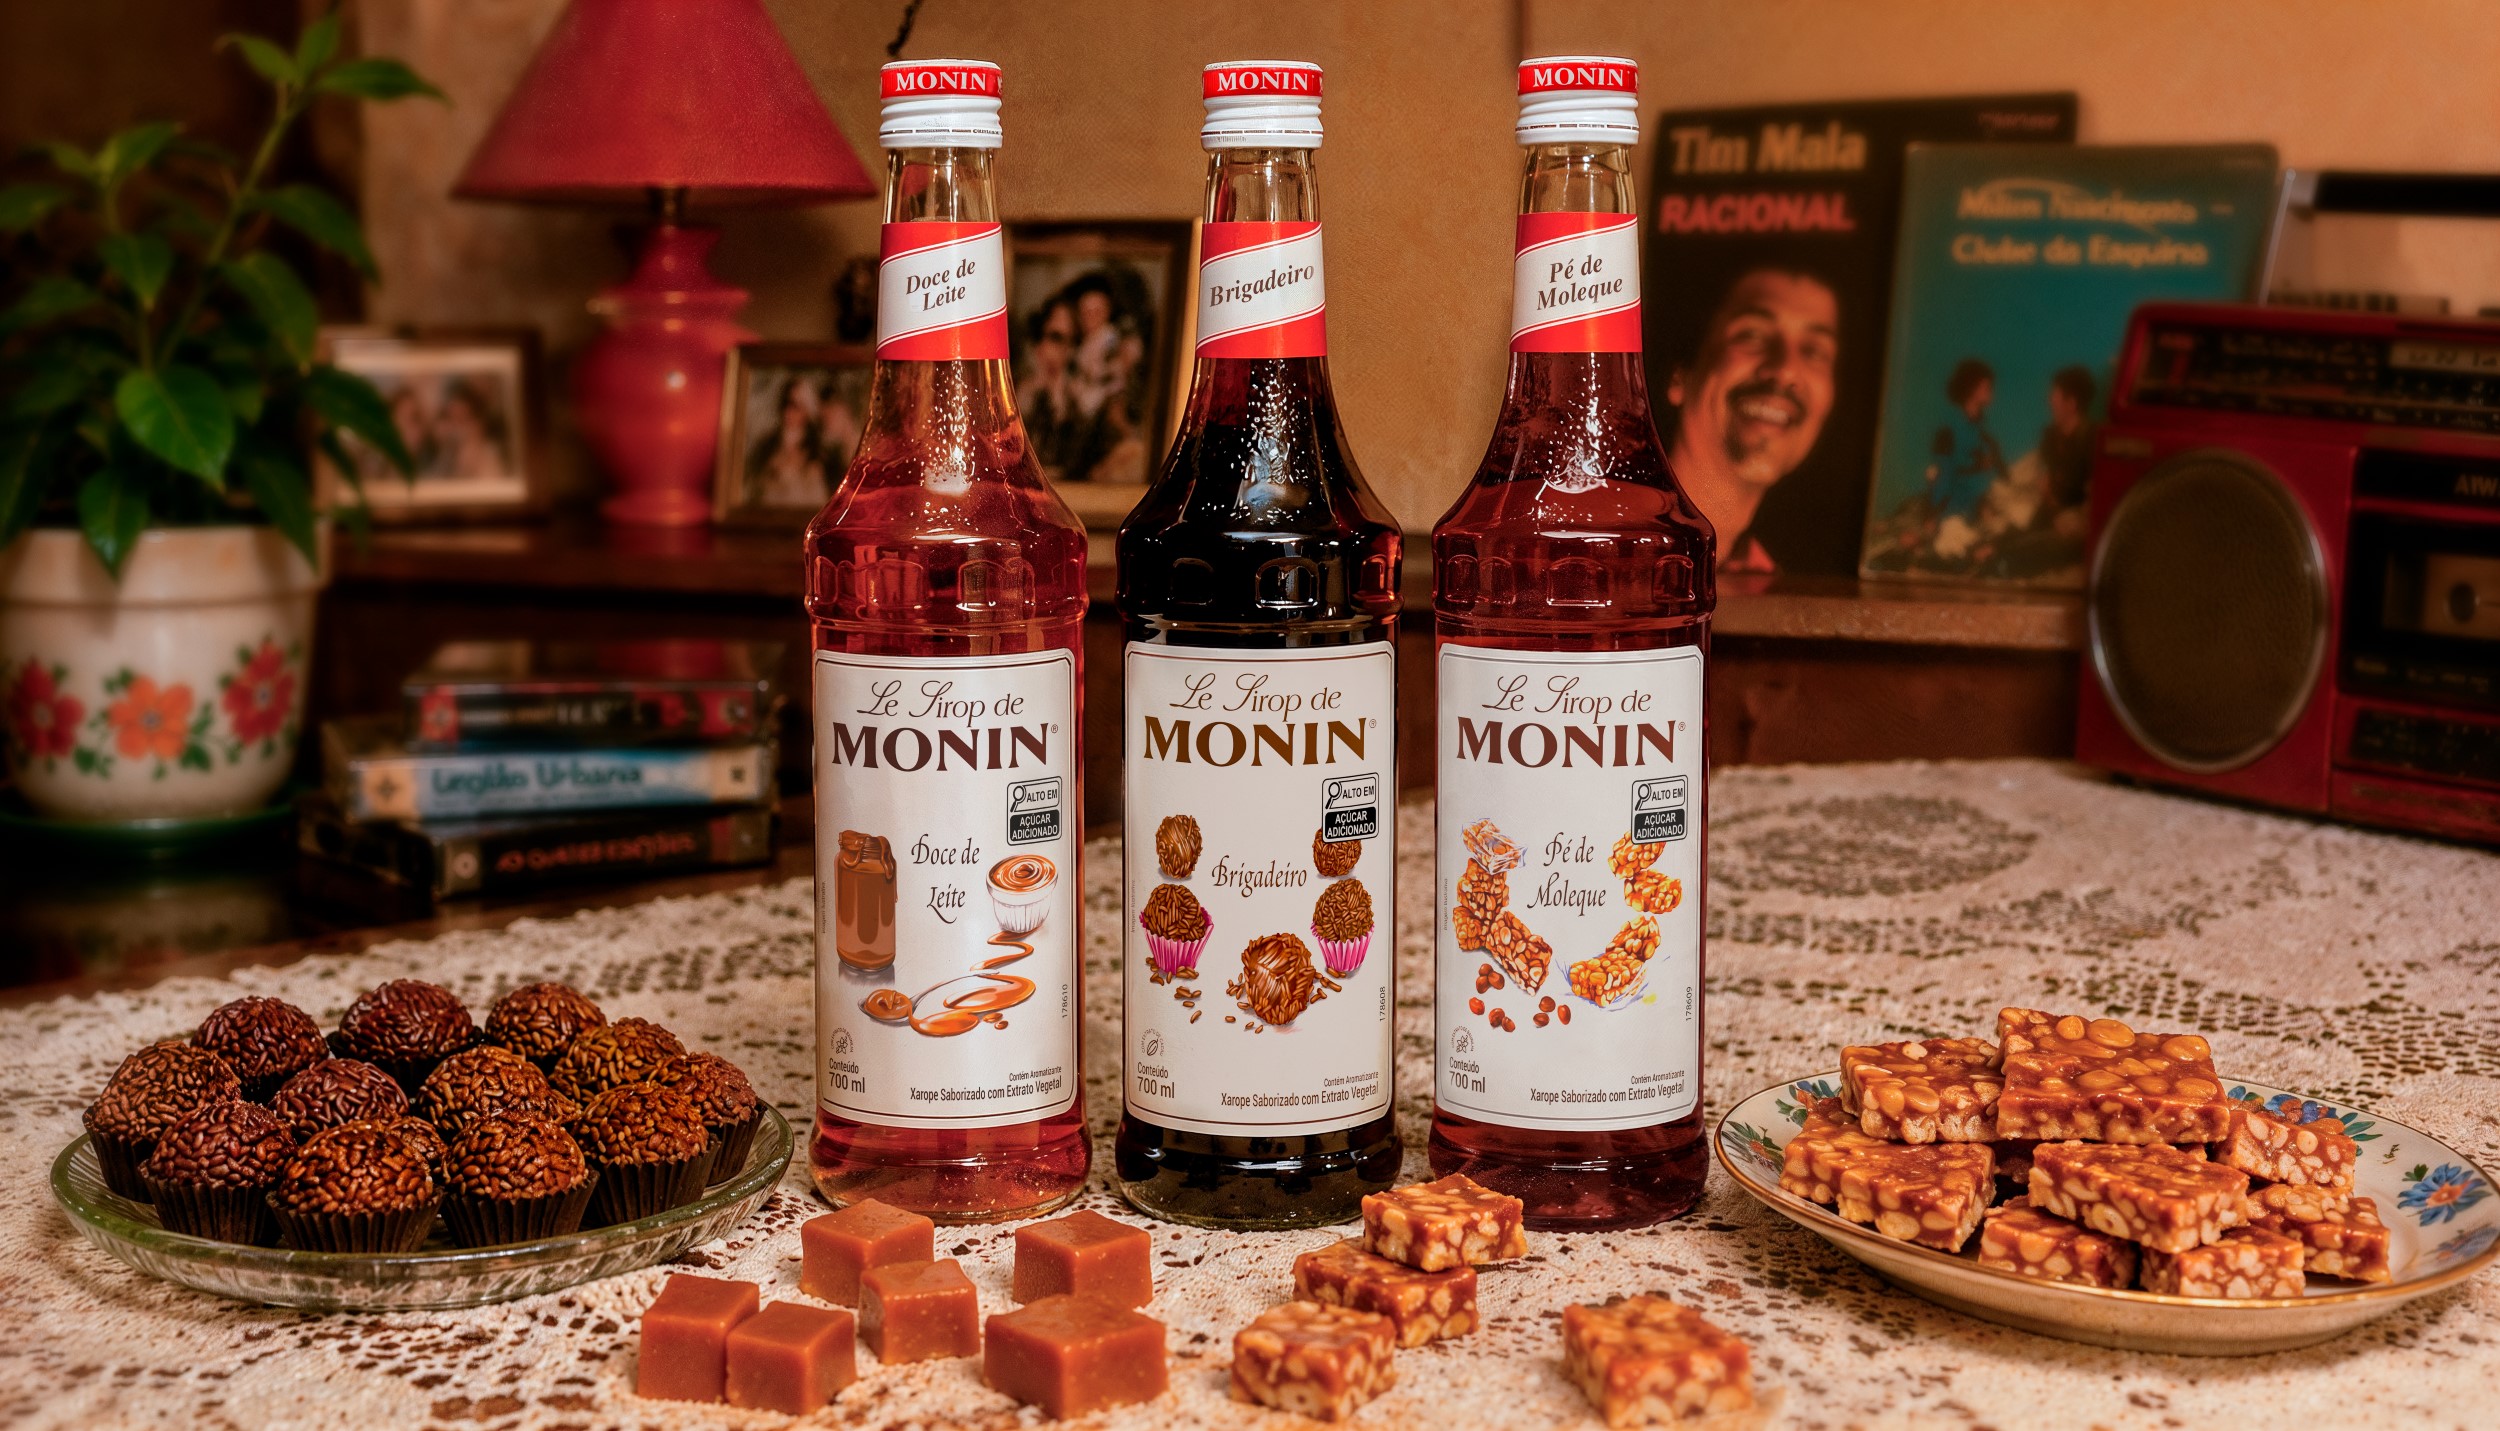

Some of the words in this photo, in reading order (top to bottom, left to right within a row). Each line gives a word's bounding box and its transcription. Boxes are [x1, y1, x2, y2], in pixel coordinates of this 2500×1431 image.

[895, 71, 987, 92] MONIN
[1217, 71, 1308, 92] MONIN
[1532, 67, 1624, 88] MONIN
[1659, 192, 1855, 232] RACIONAL
[906, 271, 950, 295] Doce
[956, 258, 976, 280] de
[1549, 257, 1575, 285] Pé
[1580, 254, 1603, 275] de
[1209, 262, 1315, 307] Brigadeiro
[1536, 276, 1623, 311] Moleque
[922, 285, 966, 312] Leite
[2454, 473, 2500, 497] AIW
[857, 680, 901, 716] Le
[909, 680, 985, 727] Sirop
[994, 694, 1024, 716] de
[1169, 673, 1216, 710] Le
[1223, 673, 1302, 722] Sirop
[1311, 687, 1342, 709] de
[1482, 675, 1528, 711] Le
[1535, 675, 1612, 724] Sirop
[1621, 690, 1651, 712] de
[1027, 790, 1046, 803] ALTO
[1047, 788, 1058, 800] EM
[1342, 787, 1362, 800] ALTO
[1363, 785, 1374, 797] EM
[1652, 789, 1671, 802] ALTO
[1672, 787, 1683, 799] EM
[1019, 812, 1051, 829] AÇÚCAR
[1335, 810, 1368, 826] AÇÚCAR
[1644, 812, 1676, 828] AÇÚCAR
[1012, 825, 1059, 840] ADICIONADO
[1327, 822, 1375, 838] ADICIONADO
[1636, 823, 1683, 839] ADICIONADO
[911, 834, 956, 865] Doce
[961, 838, 980, 865] de
[1543, 832, 1572, 866] Pé
[1575, 836, 1595, 863] de
[1211, 855, 1307, 898] Brigadeiro
[927, 884, 965, 924] Leite
[1527, 872, 1607, 916] Moleque
[1685, 986, 1693, 1021] 178609
[829, 1057, 859, 1075] Conteúdo
[1009, 1071, 1028, 1082] Contém
[1030, 1066, 1062, 1079] Aromatizante
[1137, 1062, 1169, 1079] Conteúdo
[1449, 1056, 1480, 1074] Conteúdo
[829, 1073, 849, 1091] 700
[852, 1076, 865, 1093] ml
[1137, 1076, 1158, 1095] 700
[1161, 1082, 1175, 1099] ml
[1323, 1077, 1344, 1088] Contém
[1345, 1071, 1379, 1085] Aromatizante
[1449, 1071, 1469, 1090] 700
[1471, 1076, 1486, 1093] ml
[1630, 1075, 1651, 1085] Contém
[1652, 1070, 1684, 1083] Aromatizante
[910, 1088, 939, 1103] Xarope
[940, 1087, 985, 1101] Saborizado
[988, 1089, 1004, 1099] com
[1007, 1083, 1034, 1097] Extrato
[1035, 1075, 1062, 1097] Vegetal
[1221, 1093, 1251, 1109] Xarope
[1252, 1093, 1300, 1107] Saborizado
[1302, 1093, 1320, 1105] com
[1321, 1087, 1350, 1103] Extrato
[1351, 1081, 1379, 1100] Vegetal
[1530, 1088, 1559, 1105] Xarope
[1560, 1089, 1607, 1103] Saborizado
[1608, 1090, 1627, 1102] com
[1628, 1085, 1656, 1100] Extrato
[1657, 1080, 1684, 1098] Vegetal
